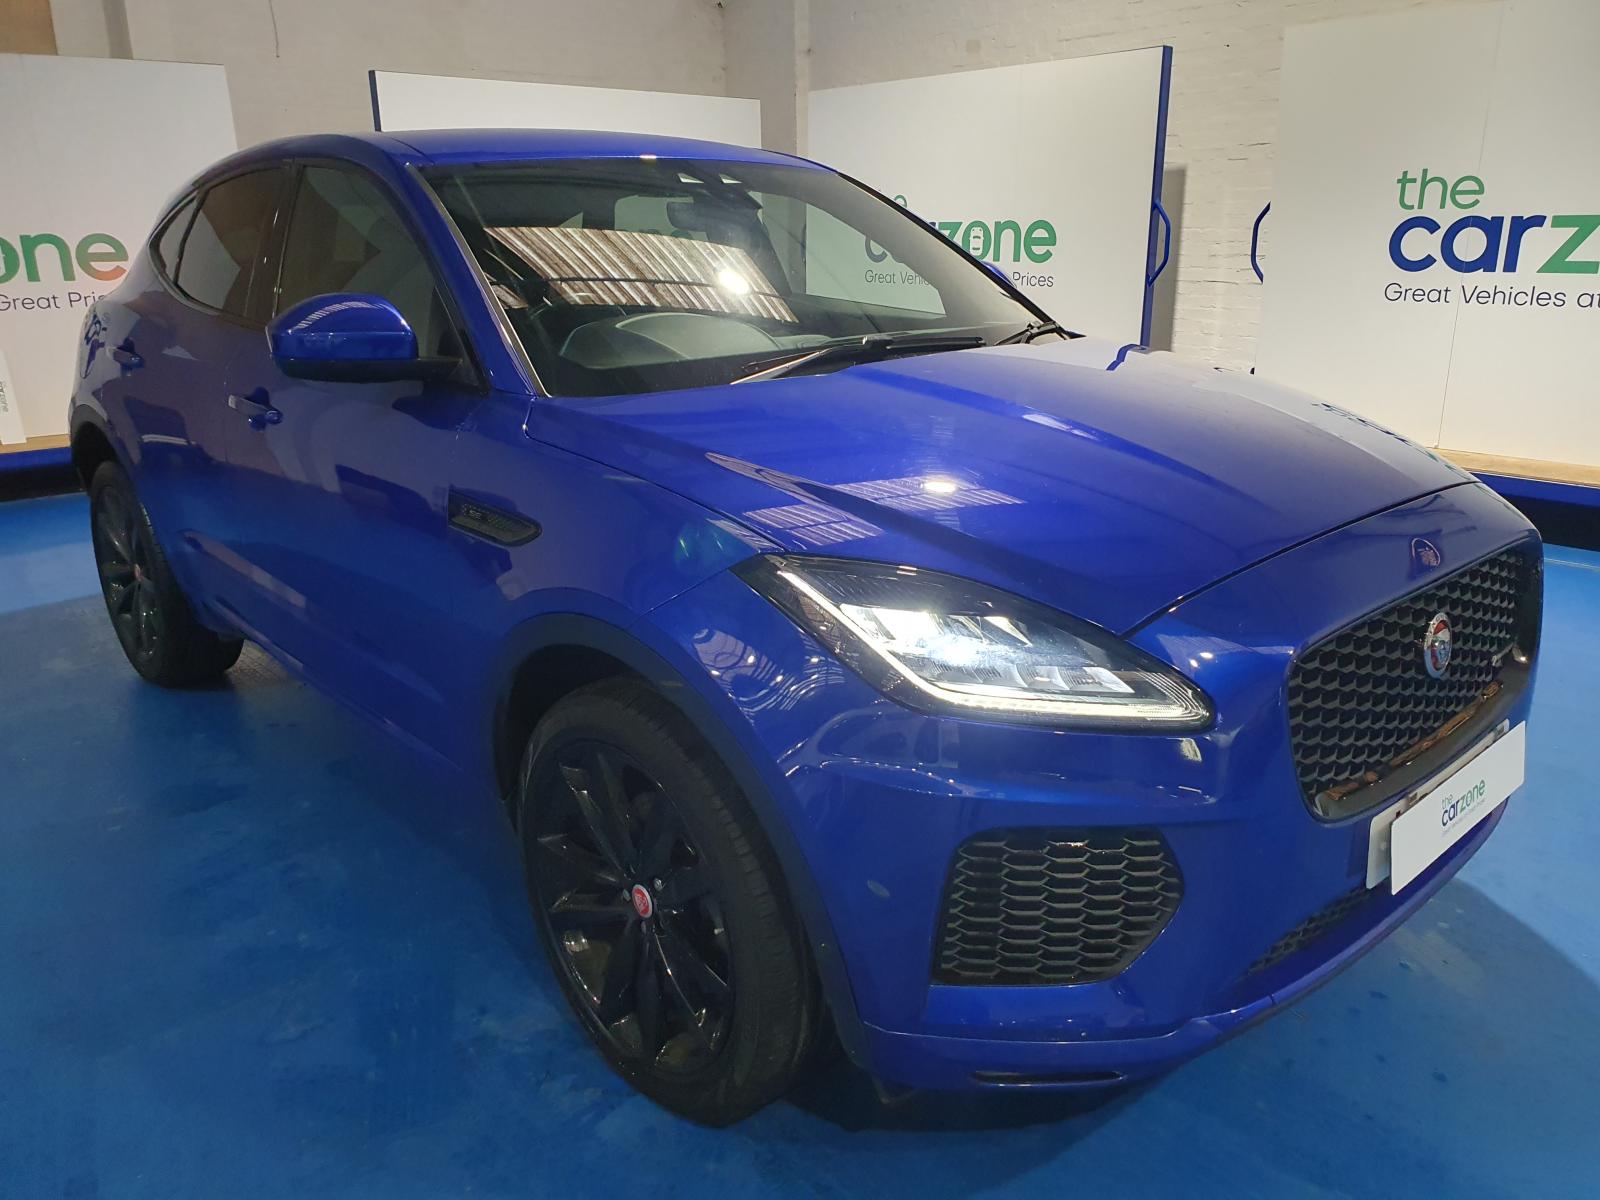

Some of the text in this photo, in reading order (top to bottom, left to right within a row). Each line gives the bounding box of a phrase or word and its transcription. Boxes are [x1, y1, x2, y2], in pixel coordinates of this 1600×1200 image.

[1397, 168, 1485, 210] the
[865, 269, 896, 284] Great
[1012, 271, 1054, 288] Prices
[1384, 282, 1452, 304] Great
[1461, 285, 1567, 308] Vehicles
[1441, 779, 1486, 827] carzone
